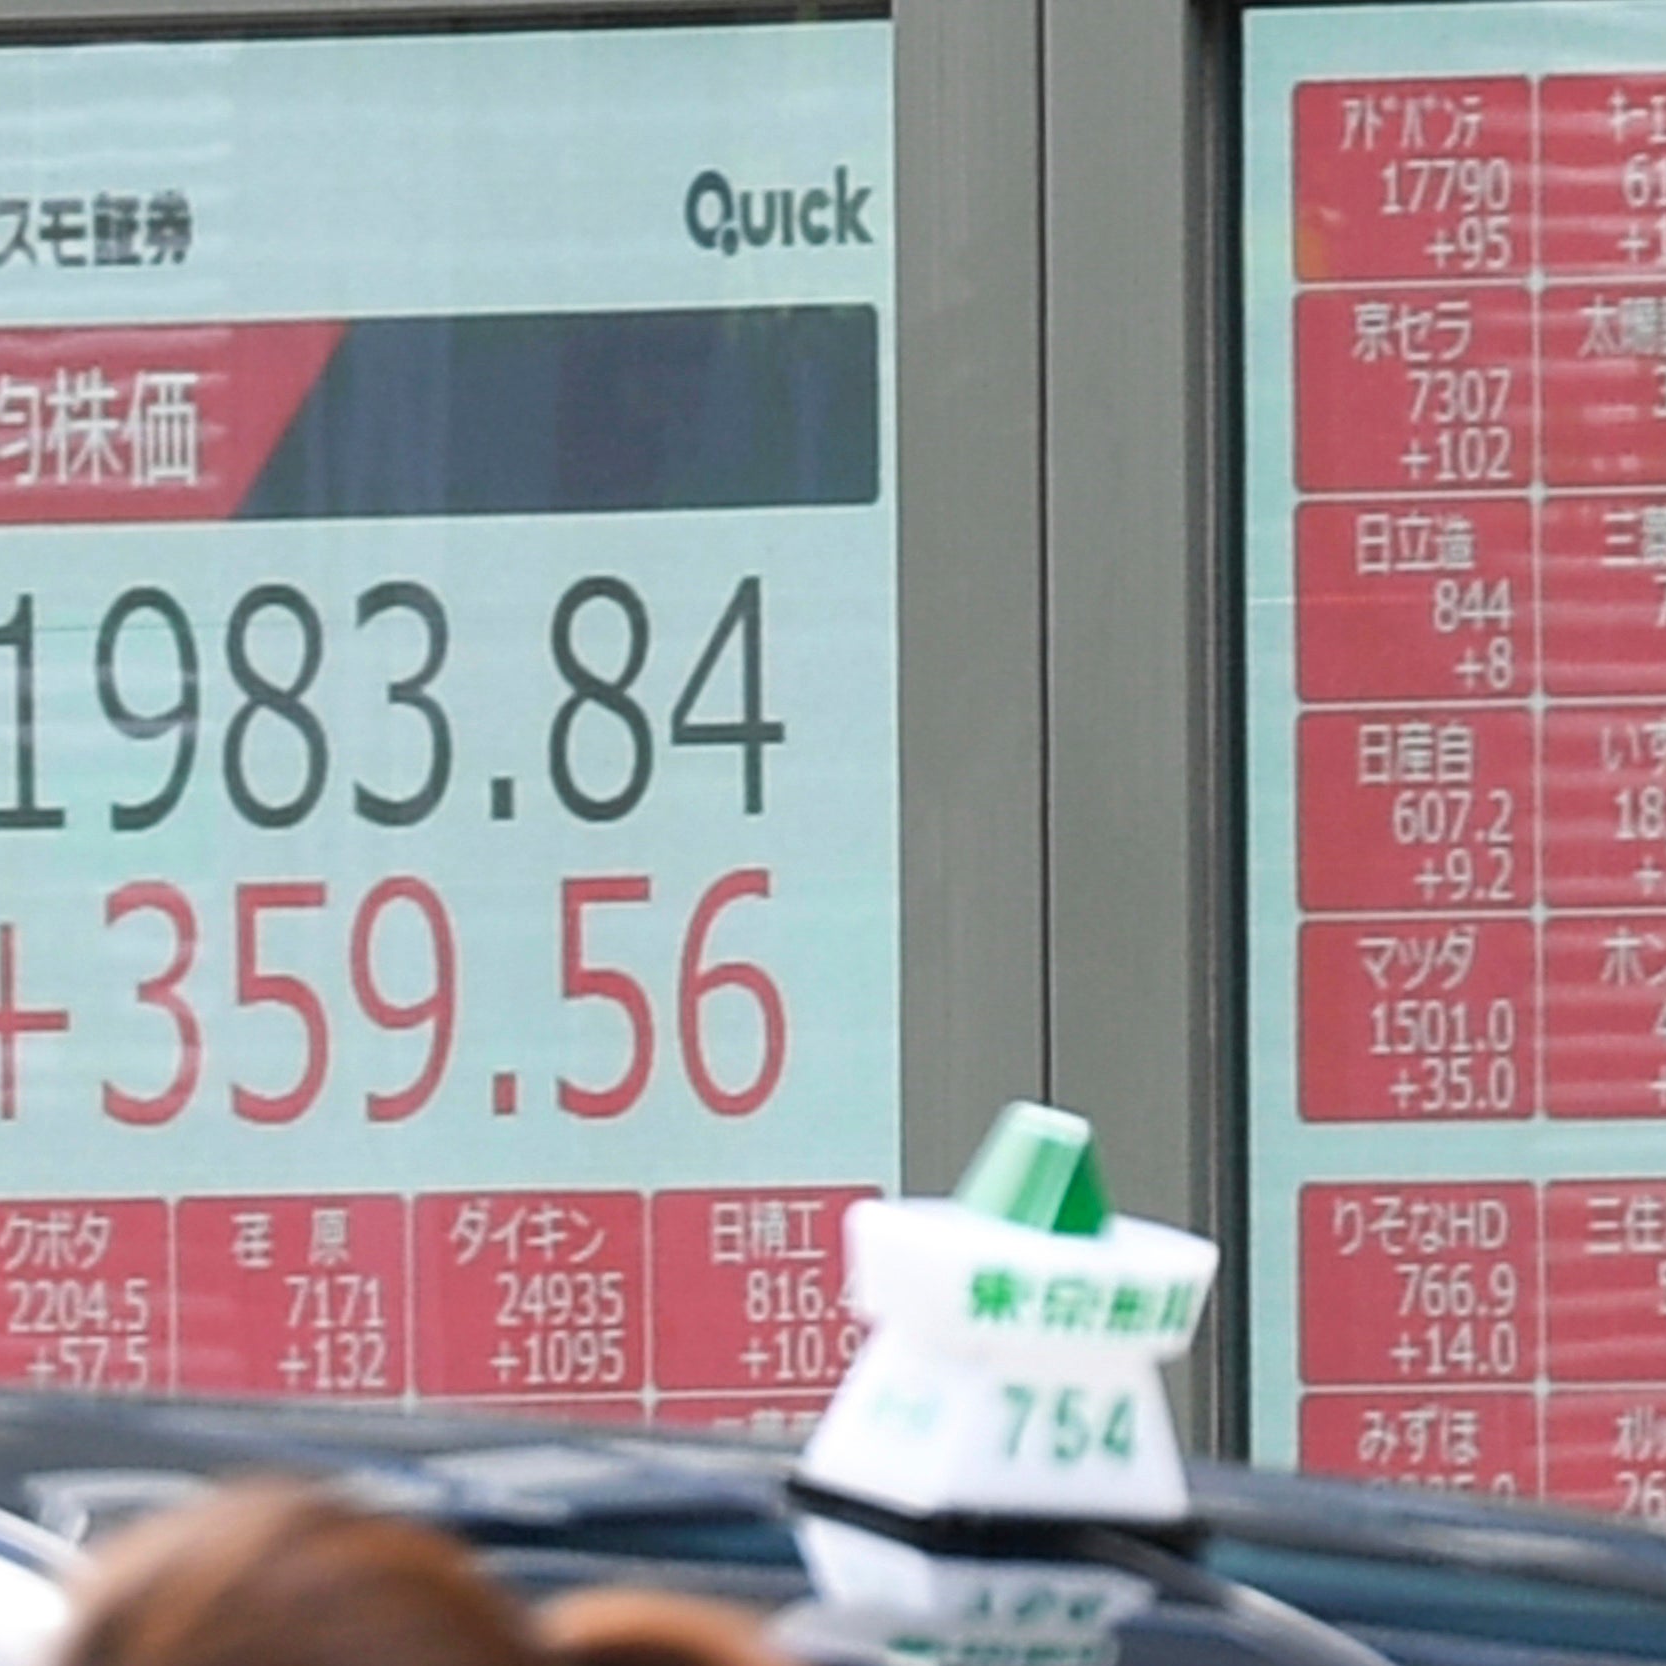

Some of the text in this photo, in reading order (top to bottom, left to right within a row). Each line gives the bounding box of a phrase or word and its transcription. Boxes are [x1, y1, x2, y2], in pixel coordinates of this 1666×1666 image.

[684, 165, 876, 258] Quick
[1380, 158, 1512, 216] 17790
[1426, 216, 1512, 269] +95
[1351, 301, 1473, 361] 京セラ
[1406, 368, 1512, 424] 7307
[1433, 579, 1513, 633] 844
[1453, 637, 1513, 689] +8
[1392, 790, 1514, 844] 607.2
[1357, 926, 1477, 991] マツダ
[1369, 1000, 1514, 1055] 1501.0
[1390, 1057, 1514, 1111] +35.0
[449, 1207, 606, 1266] ダイキン
[1332, 1196, 1510, 1256] りそなHD
[8, 1278, 149, 1332] 2204.5
[283, 1276, 385, 1327] 7171
[494, 1271, 624, 1325] 24935
[1393, 1262, 1516, 1318] 766.9
[277, 1334, 386, 1388] +132
[488, 1329, 624, 1384] +1095
[1003, 1384, 1136, 1461] 754
[1357, 1405, 1482, 1465] みずほ
